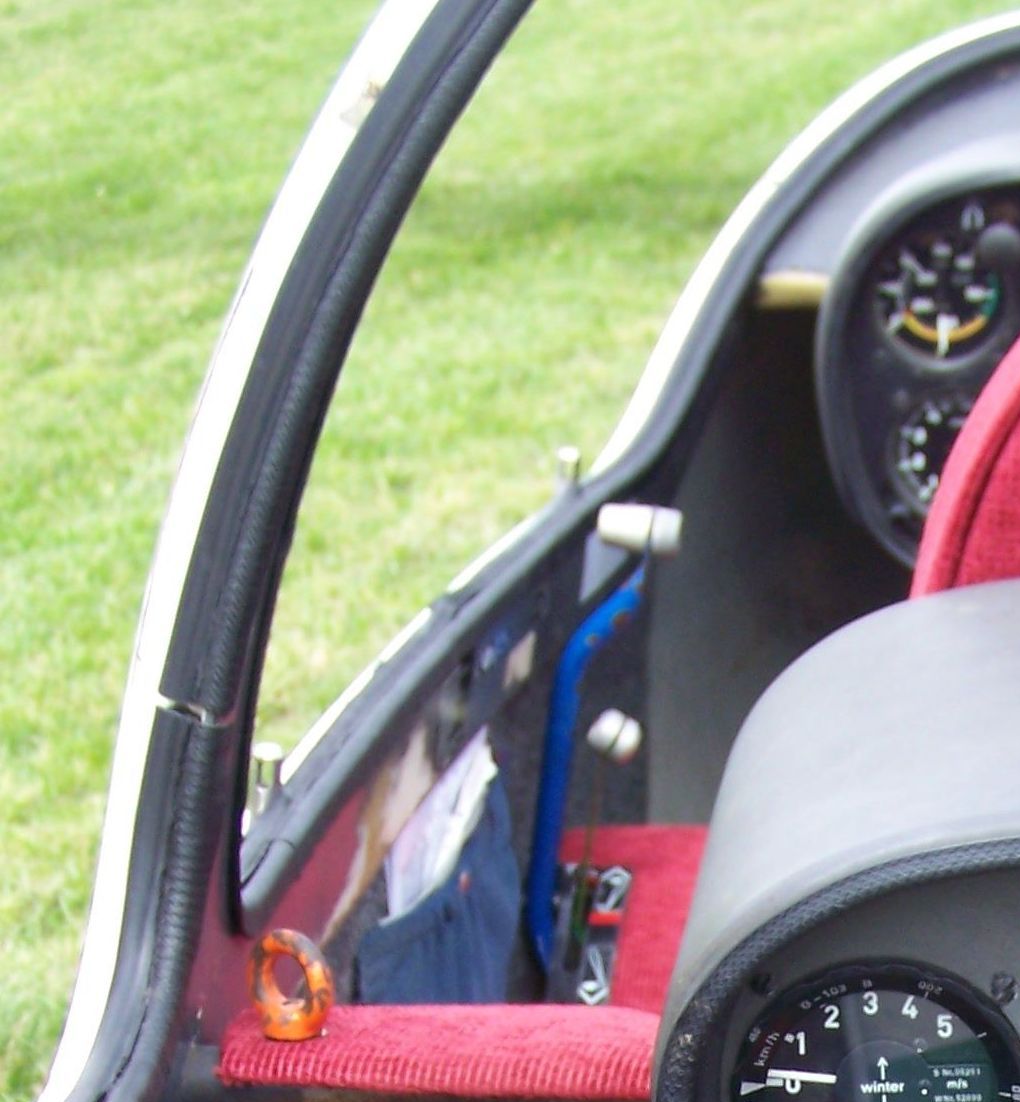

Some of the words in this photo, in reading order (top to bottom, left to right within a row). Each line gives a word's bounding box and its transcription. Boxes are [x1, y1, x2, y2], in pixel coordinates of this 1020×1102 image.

[863, 991, 879, 1015] 3
[902, 995, 919, 1019] 4
[824, 1005, 840, 1028] 2
[937, 1014, 953, 1038] 5
[753, 1032, 780, 1067] km/h
[796, 1031, 806, 1055] 1
[860, 1080, 905, 1094] winter
[946, 1078, 969, 1090] m/s
